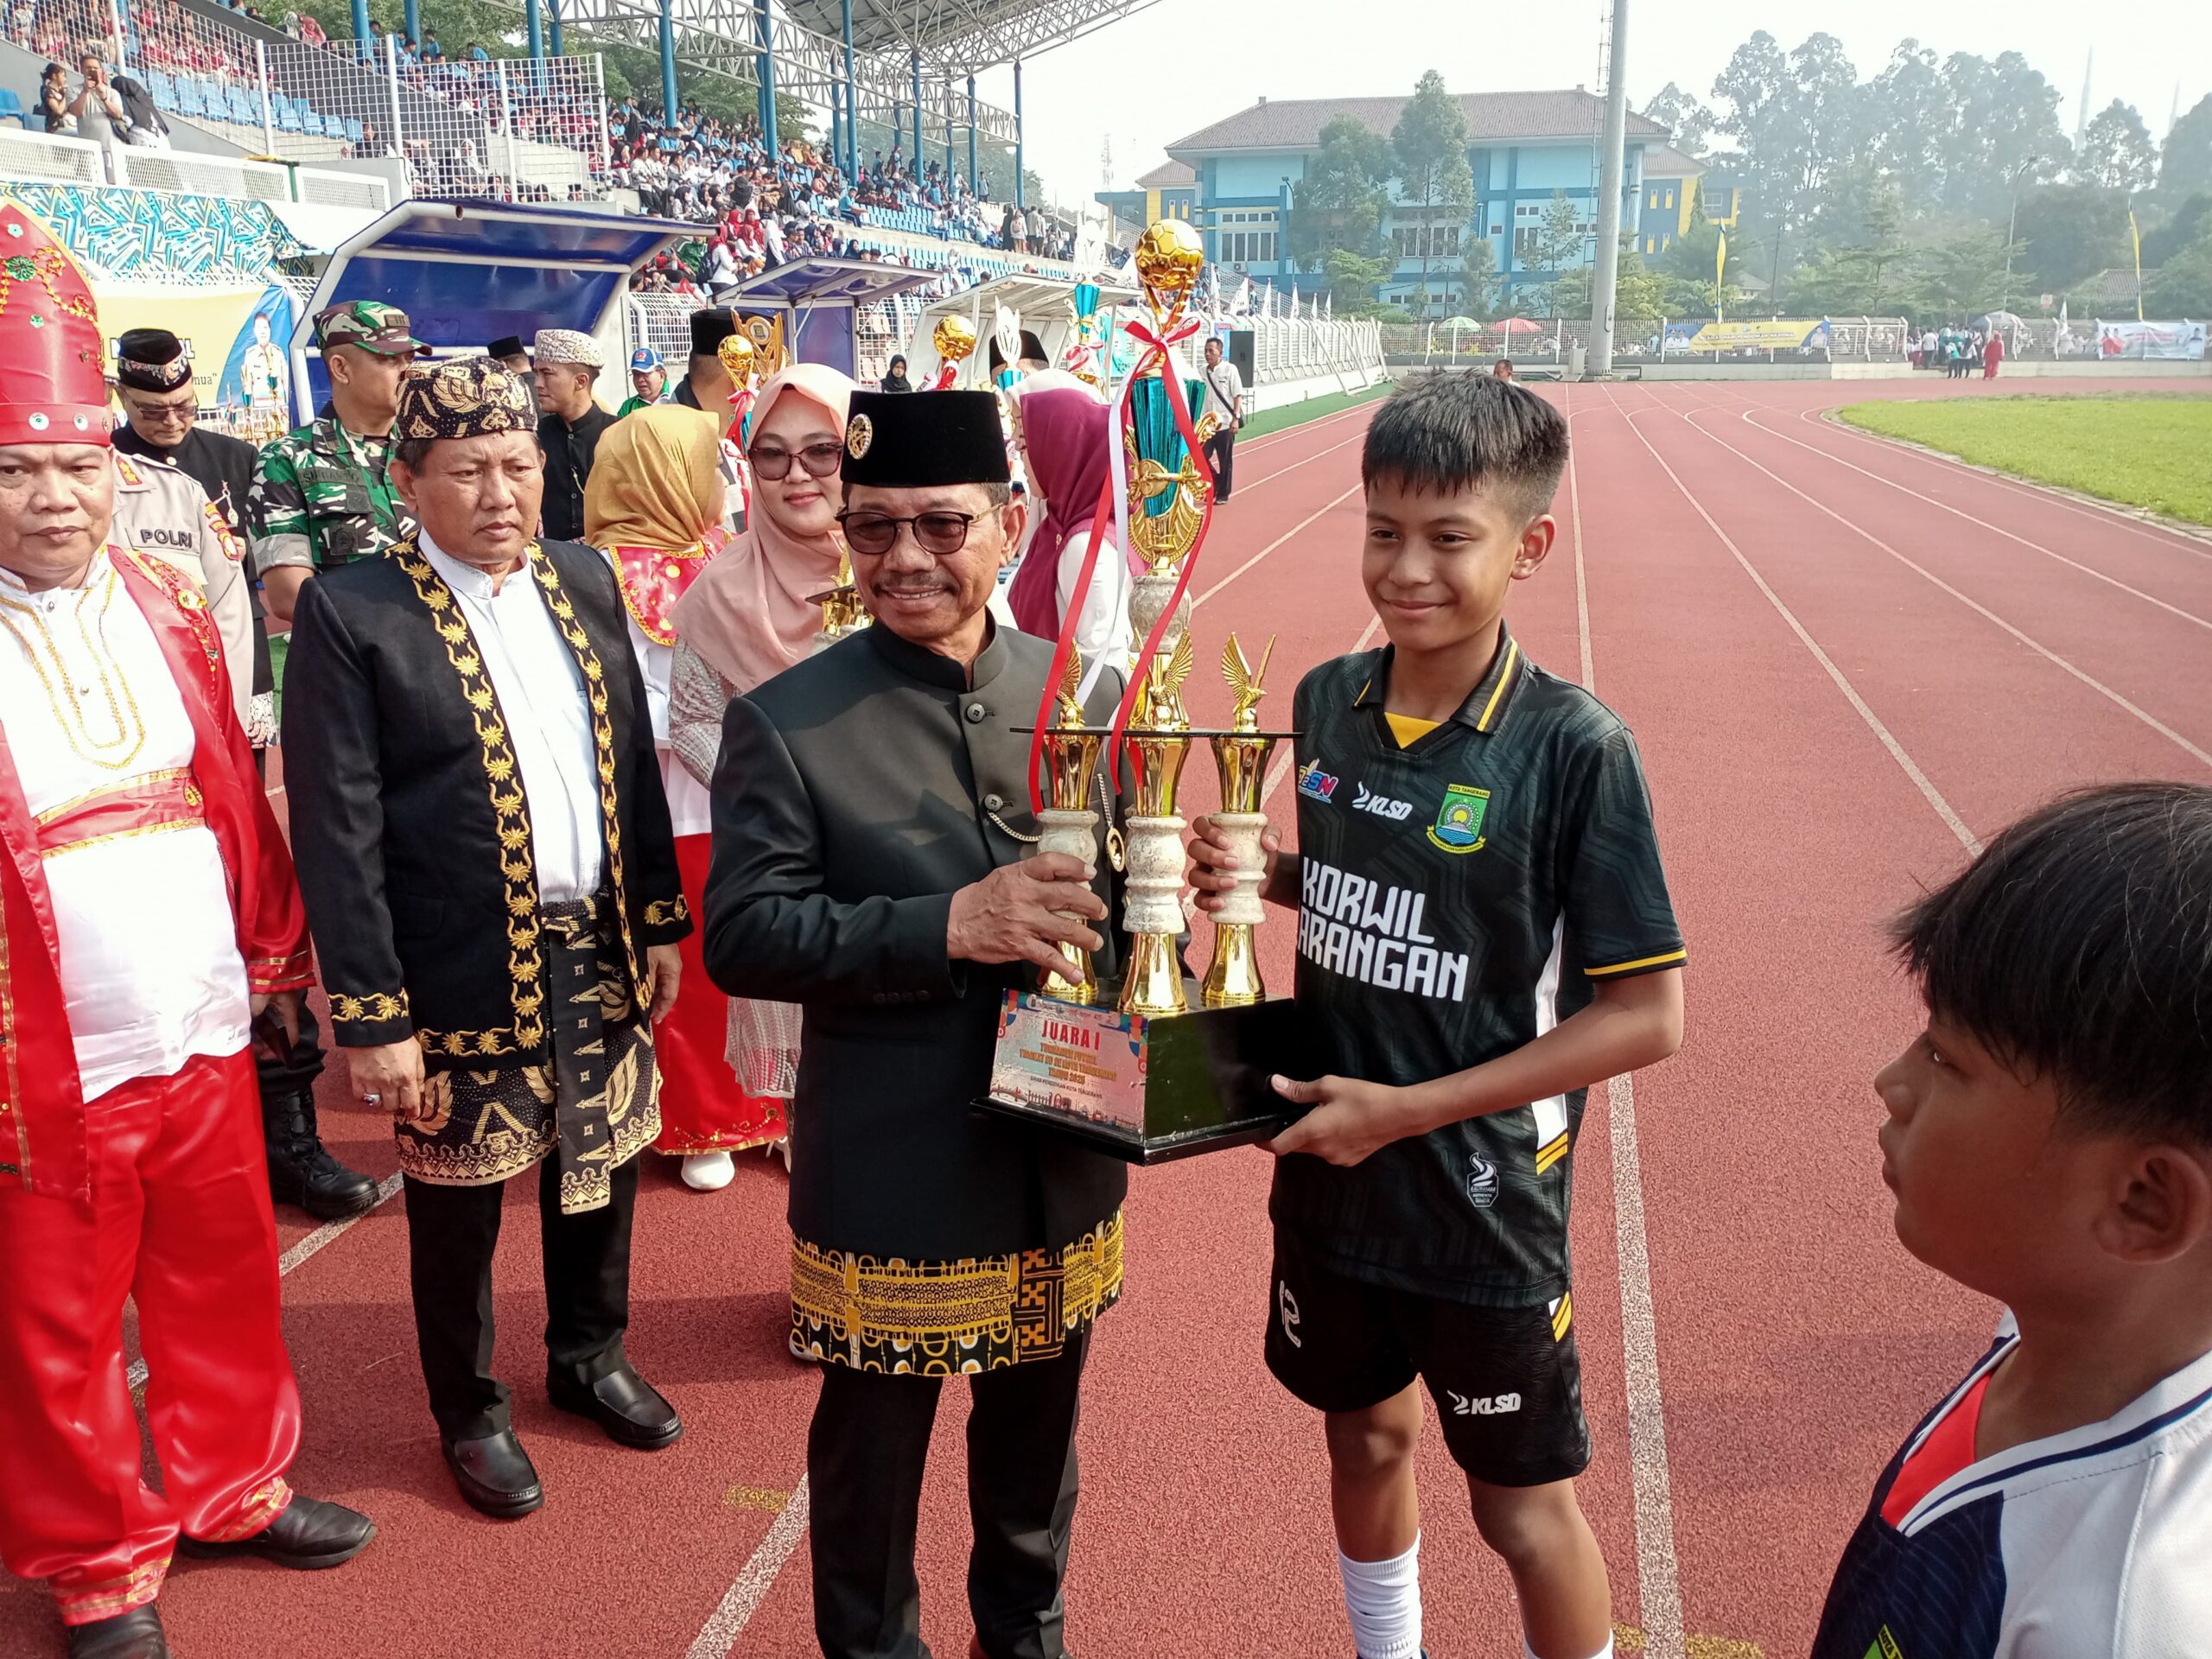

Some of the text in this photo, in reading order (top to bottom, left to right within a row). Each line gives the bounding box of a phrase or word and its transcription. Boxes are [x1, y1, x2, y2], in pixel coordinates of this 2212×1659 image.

[140, 529, 193, 548] POLRI
[1366, 794, 1414, 821] KLSD
[1302, 856, 1435, 944] KORWIL
[1298, 905, 1469, 1002] ARANGAN
[1042, 1020, 1090, 1048] JUARA
[1471, 1392, 1521, 1414] KLSD
